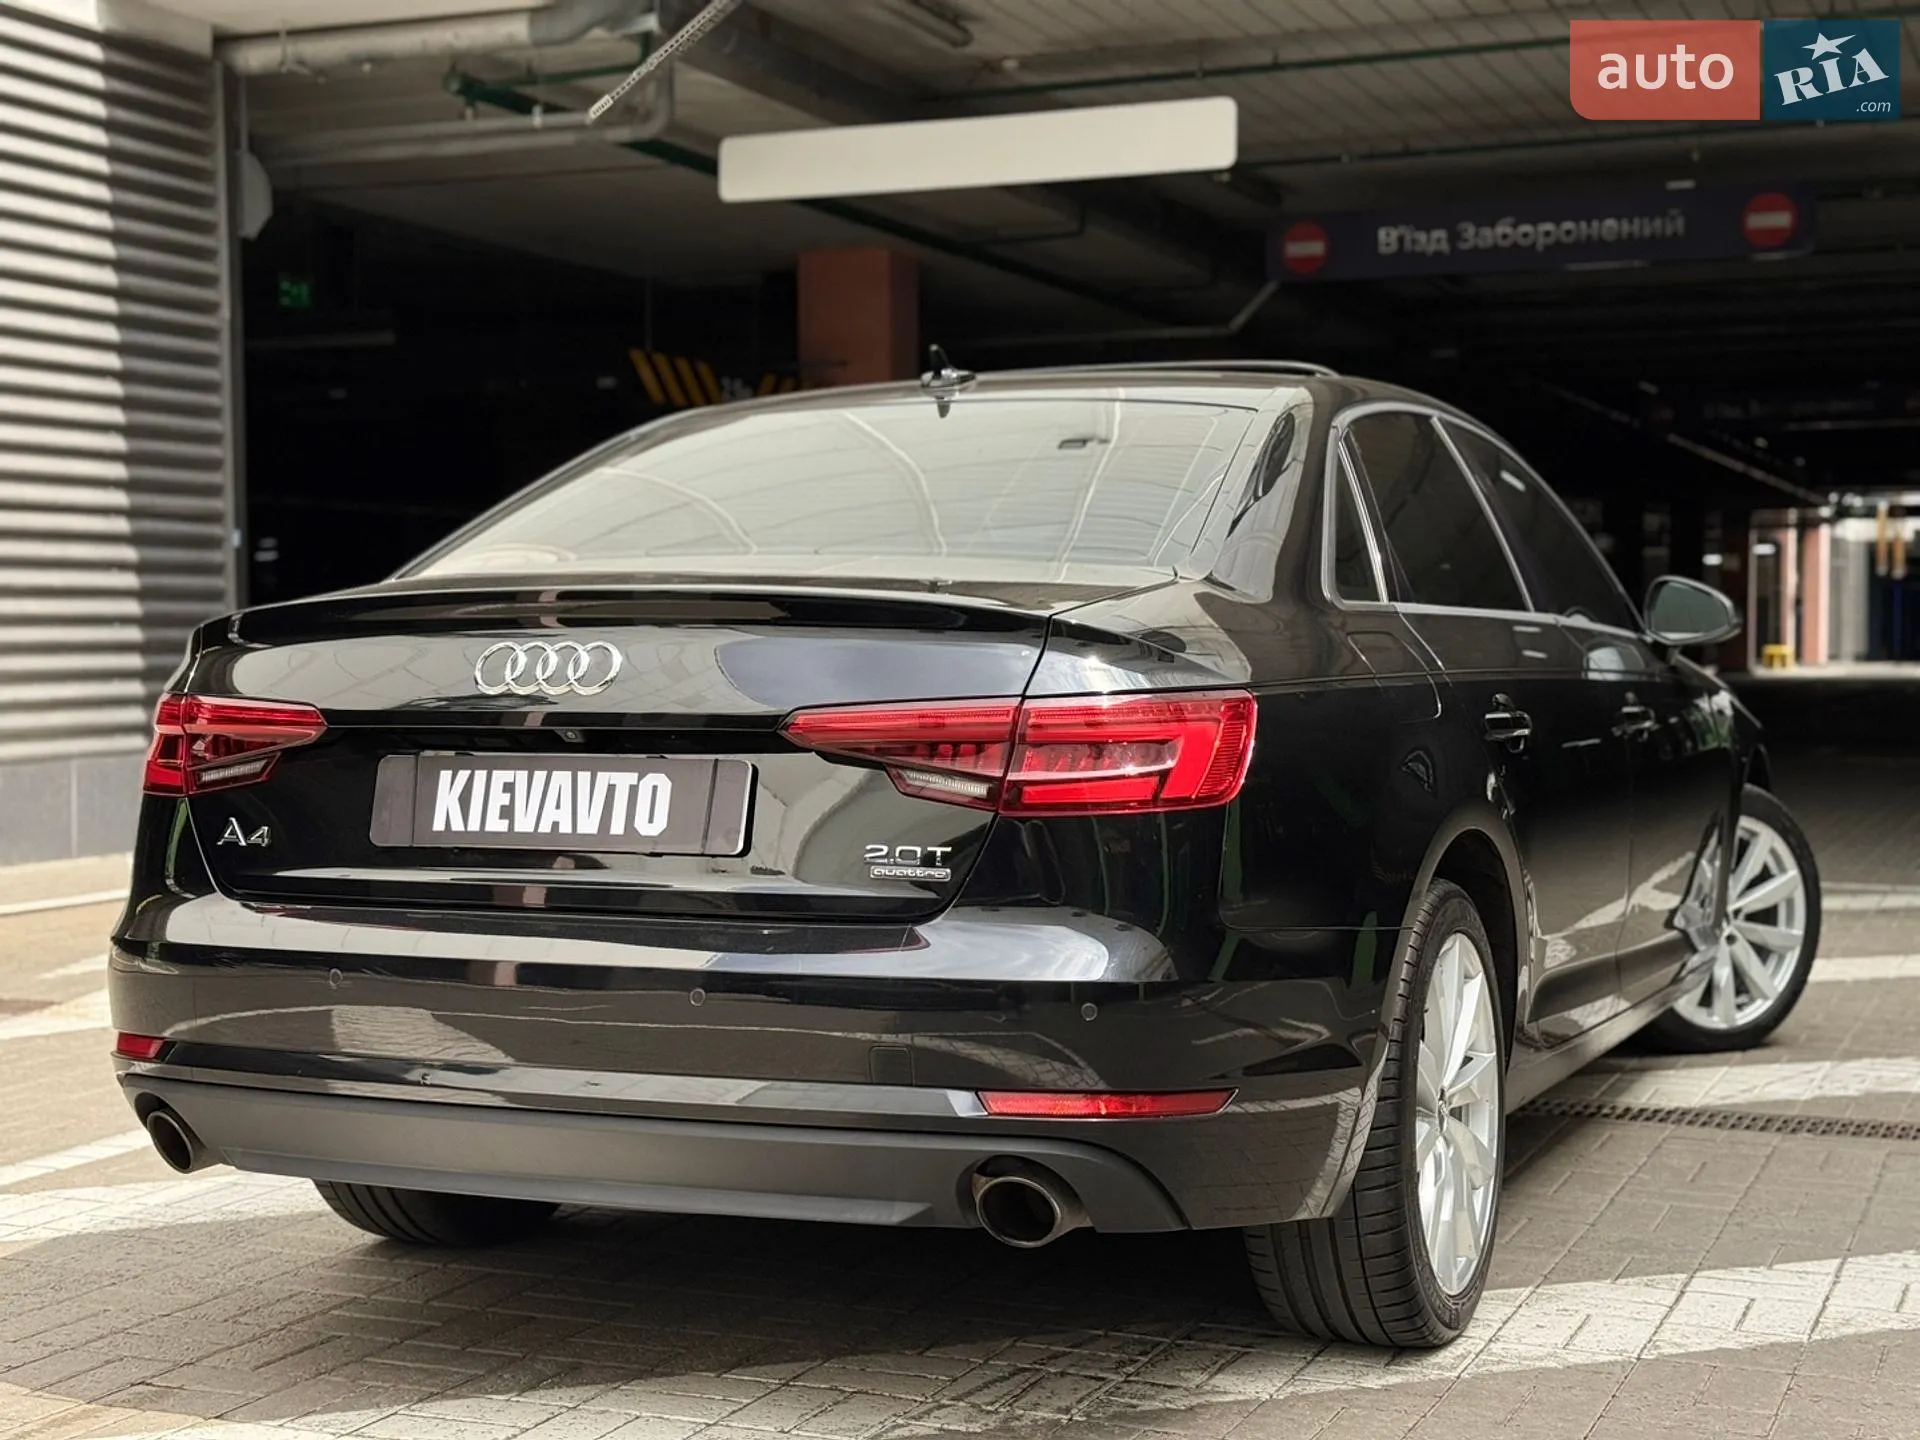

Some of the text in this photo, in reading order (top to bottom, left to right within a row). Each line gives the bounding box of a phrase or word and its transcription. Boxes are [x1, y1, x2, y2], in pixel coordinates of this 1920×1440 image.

[1456, 208, 1686, 253] Заборонений
[432, 769, 673, 837] KIEVAVTO
[216, 816, 271, 847] A4
[863, 844, 952, 866] 2.0T
[872, 867, 949, 880] quattro
